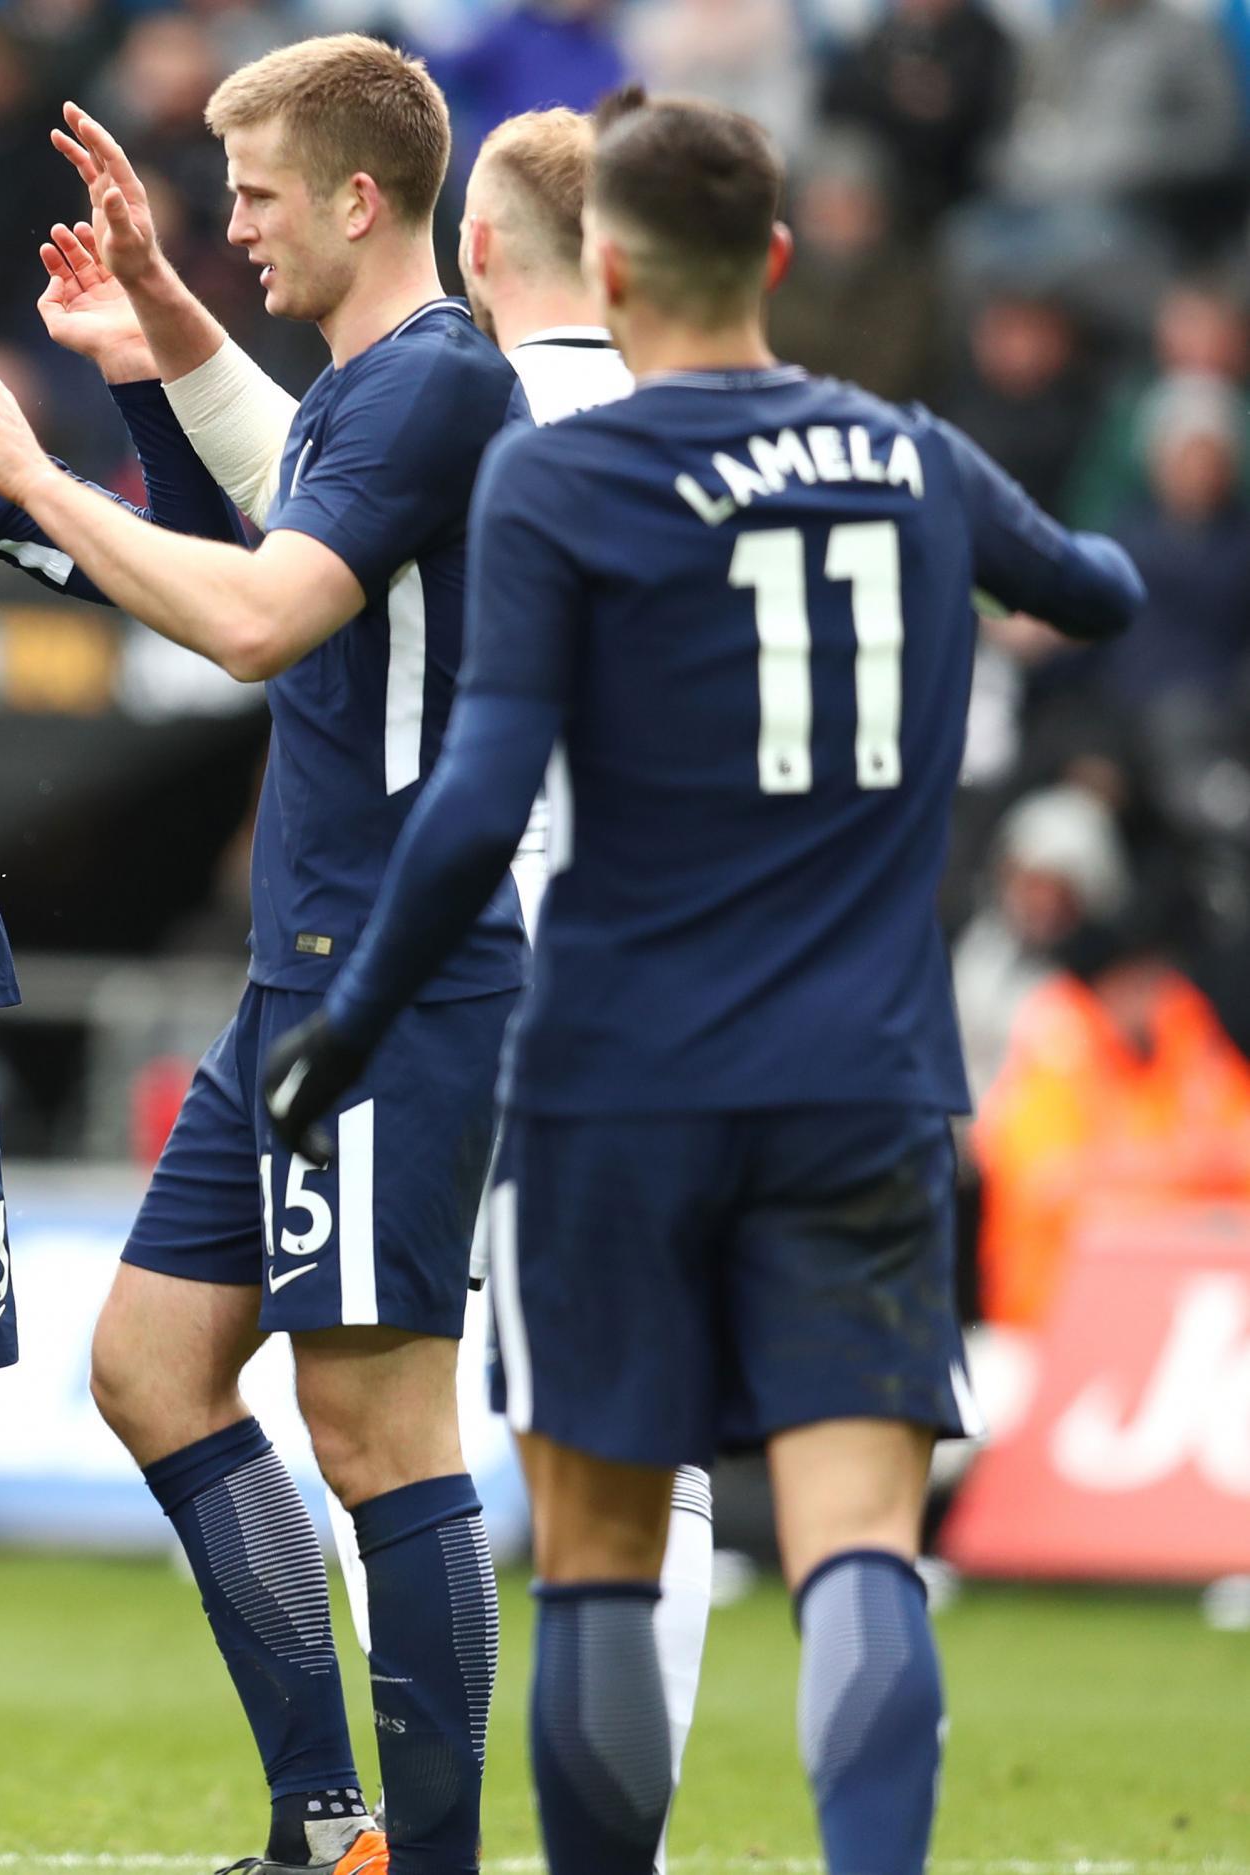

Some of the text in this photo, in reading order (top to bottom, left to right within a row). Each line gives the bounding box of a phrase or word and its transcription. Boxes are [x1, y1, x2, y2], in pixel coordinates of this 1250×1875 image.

[675, 425, 924, 527] LAMELA
[727, 520, 905, 795] 11
[260, 1151, 333, 1256] 15
